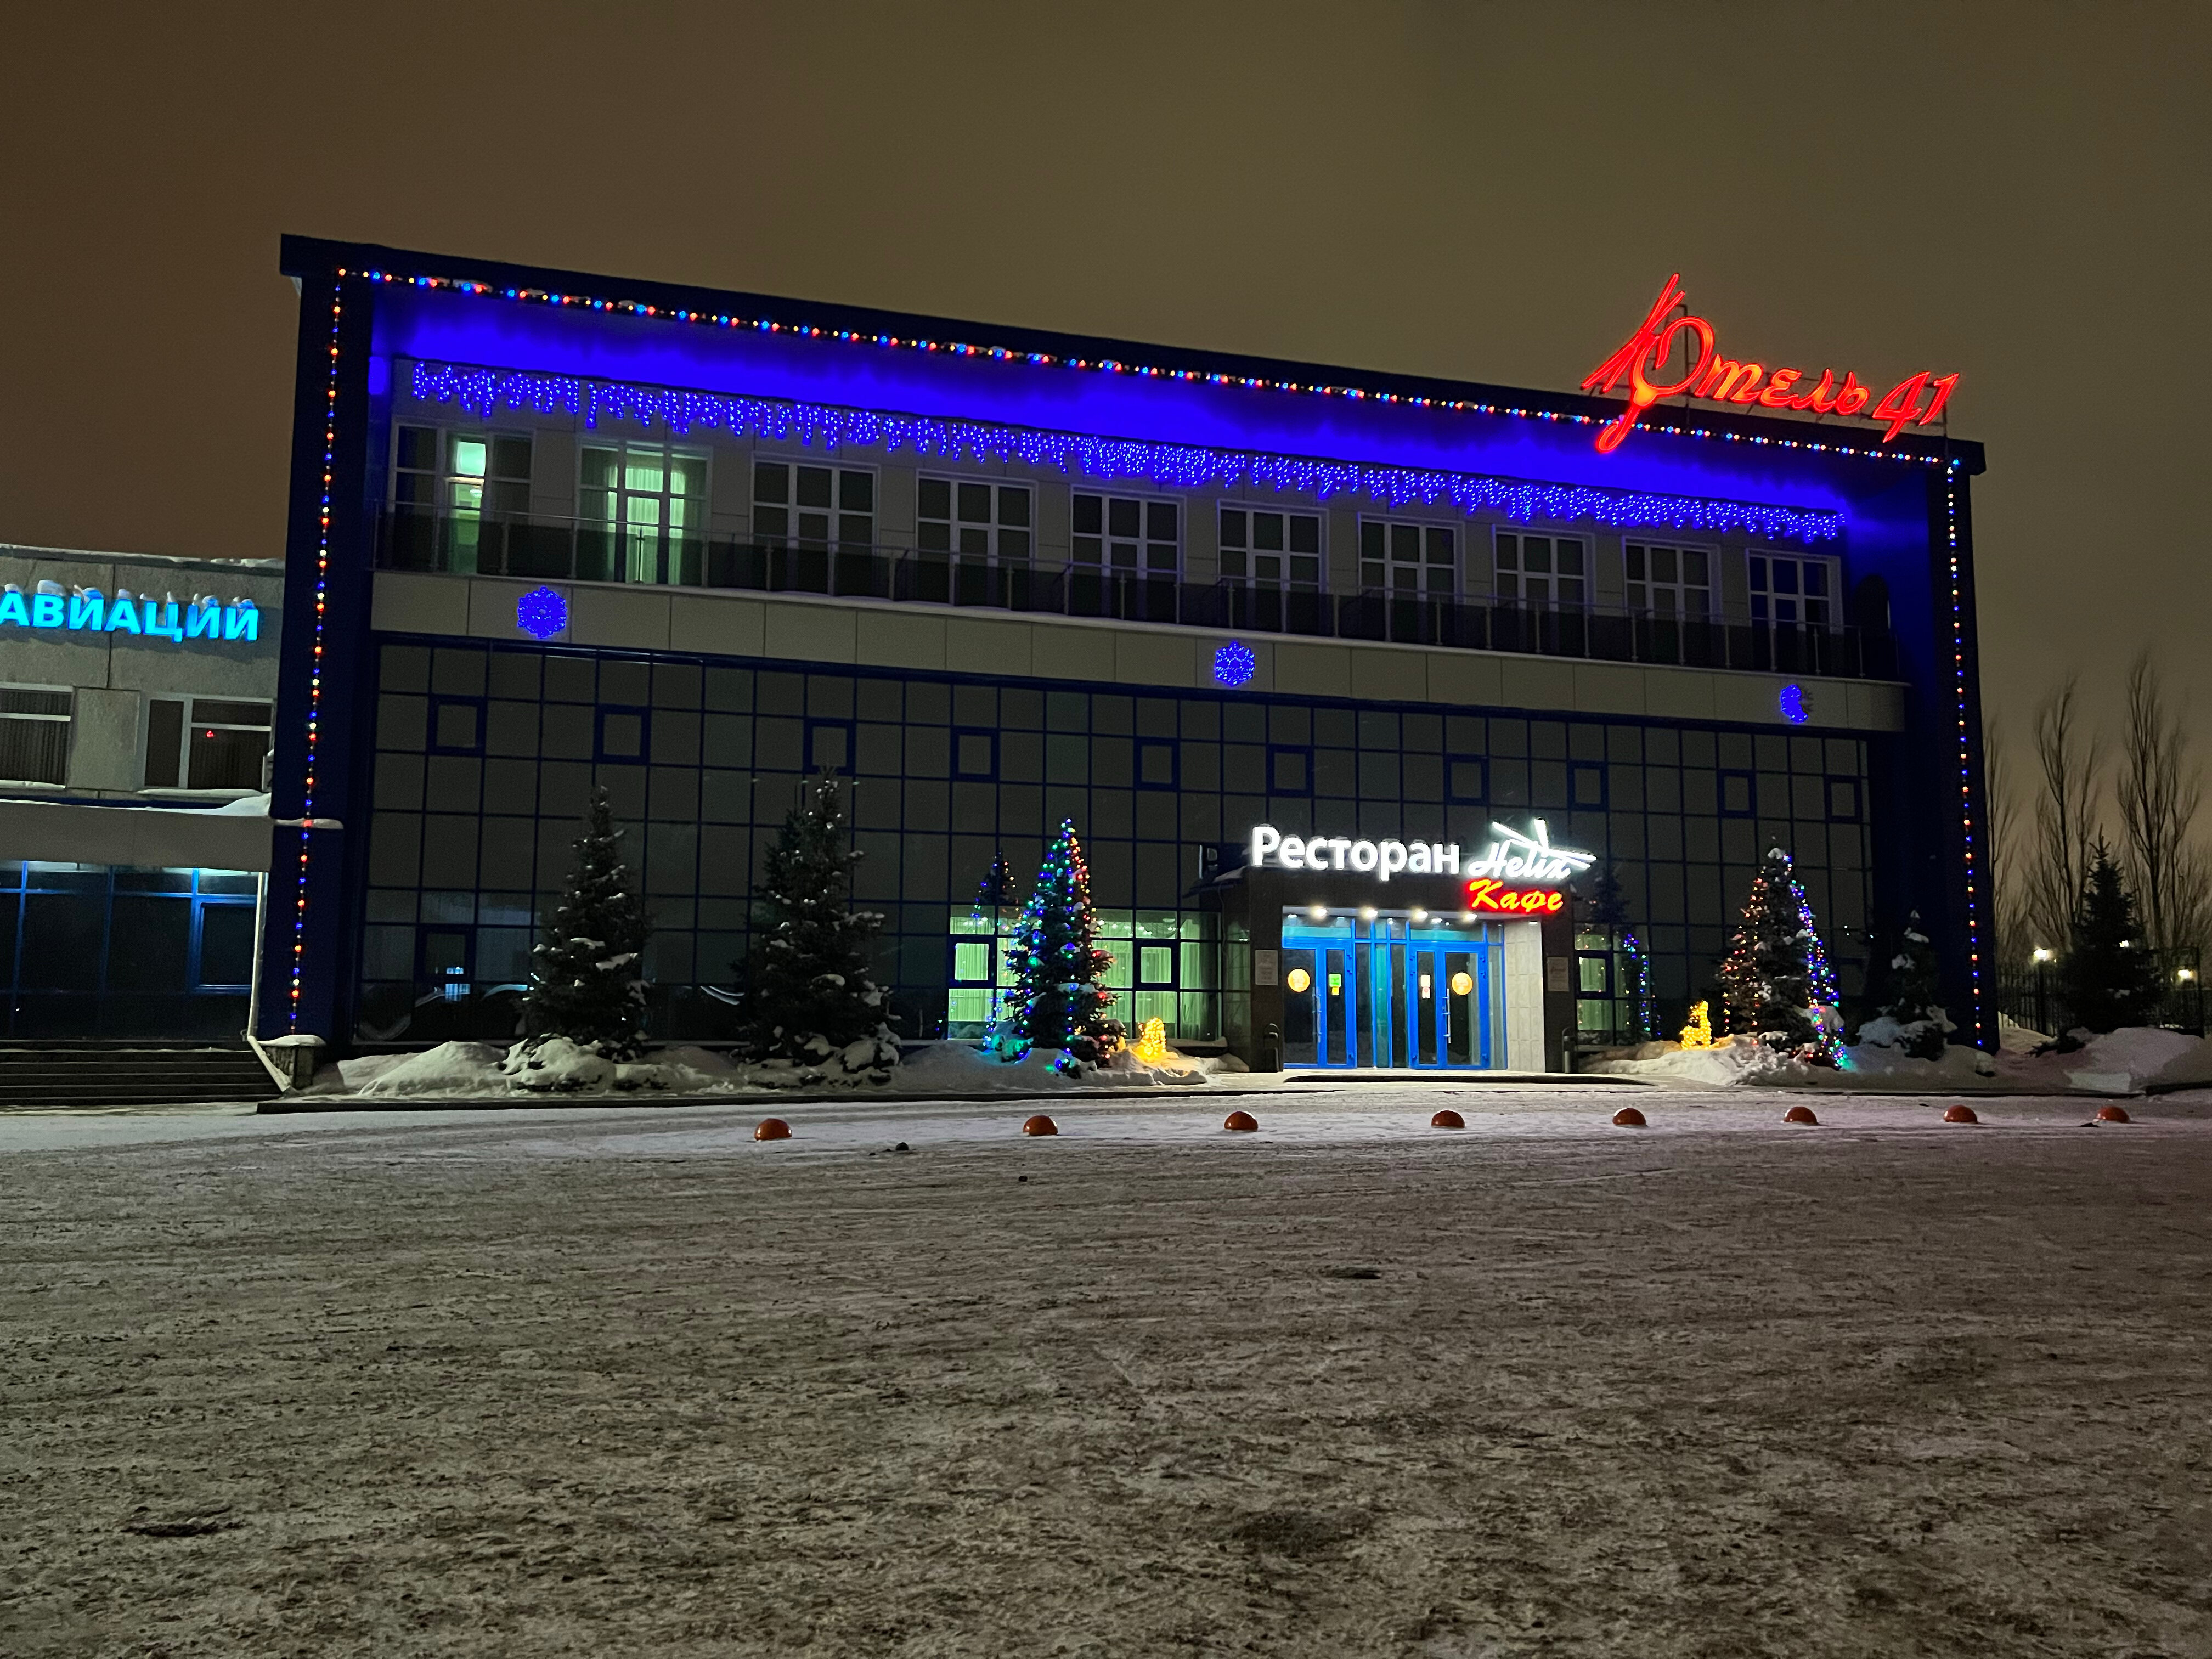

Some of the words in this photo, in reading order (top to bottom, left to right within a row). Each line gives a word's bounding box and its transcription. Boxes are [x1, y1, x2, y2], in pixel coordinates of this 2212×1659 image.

[1595, 314, 1871, 454] Отель
[1871, 371, 1960, 443] 41
[0, 590, 259, 643] АВИАЦИИ
[1252, 825, 1460, 882] Ресторан
[1467, 837, 1572, 881] Helix
[1469, 878, 1564, 913] Кафе
